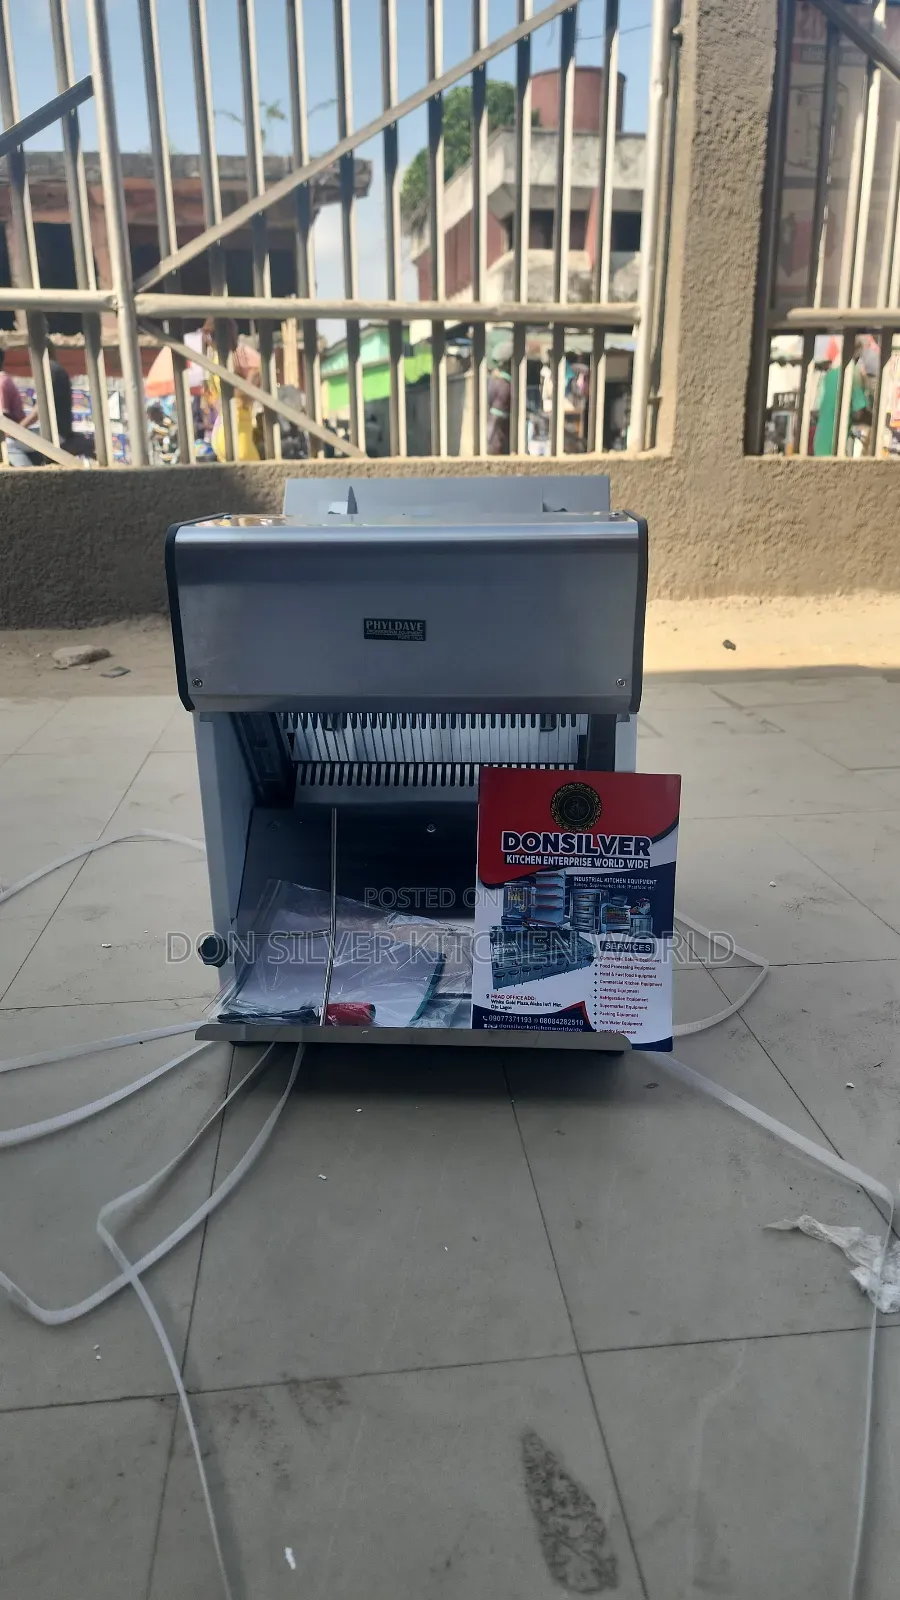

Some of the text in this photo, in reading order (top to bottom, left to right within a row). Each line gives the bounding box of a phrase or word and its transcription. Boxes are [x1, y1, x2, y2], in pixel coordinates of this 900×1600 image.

[366, 620, 423, 631] PHYLDAVE
[501, 831, 652, 857] DONSILVER
[506, 855, 649, 869] KITCHEN ENTERPRISE WORLD WIDE
[605, 942, 651, 952] SERVICES
[489, 1015, 532, 1023] 09077371193
